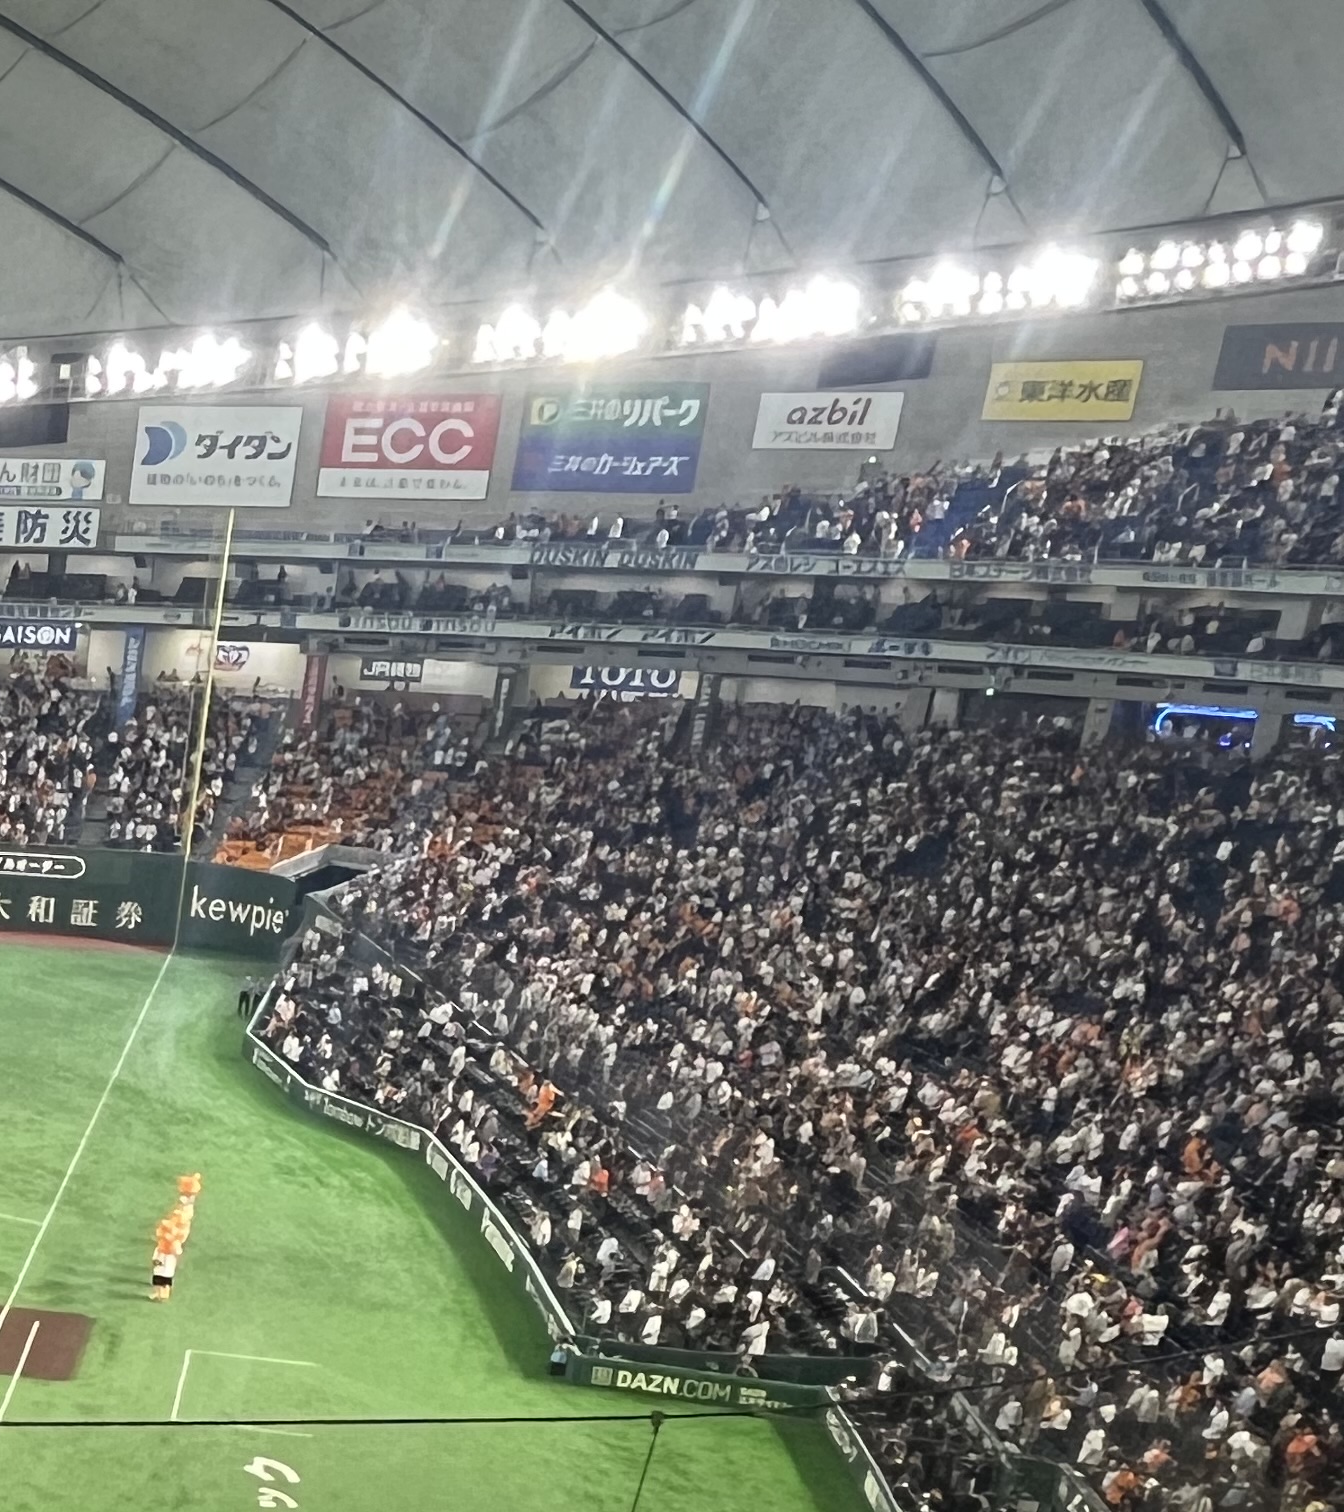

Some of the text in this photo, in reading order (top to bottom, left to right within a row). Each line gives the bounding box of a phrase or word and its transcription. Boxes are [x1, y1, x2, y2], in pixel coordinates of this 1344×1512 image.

[1019, 378, 1133, 404] 東洋水産
[570, 396, 700, 427] 三井のリパーク
[786, 398, 872, 427] azbil
[195, 430, 292, 460] ダイダン
[341, 417, 475, 465] ECC
[190, 885, 288, 937] kewpie
[616, 1370, 731, 1402] DAZN.COM
